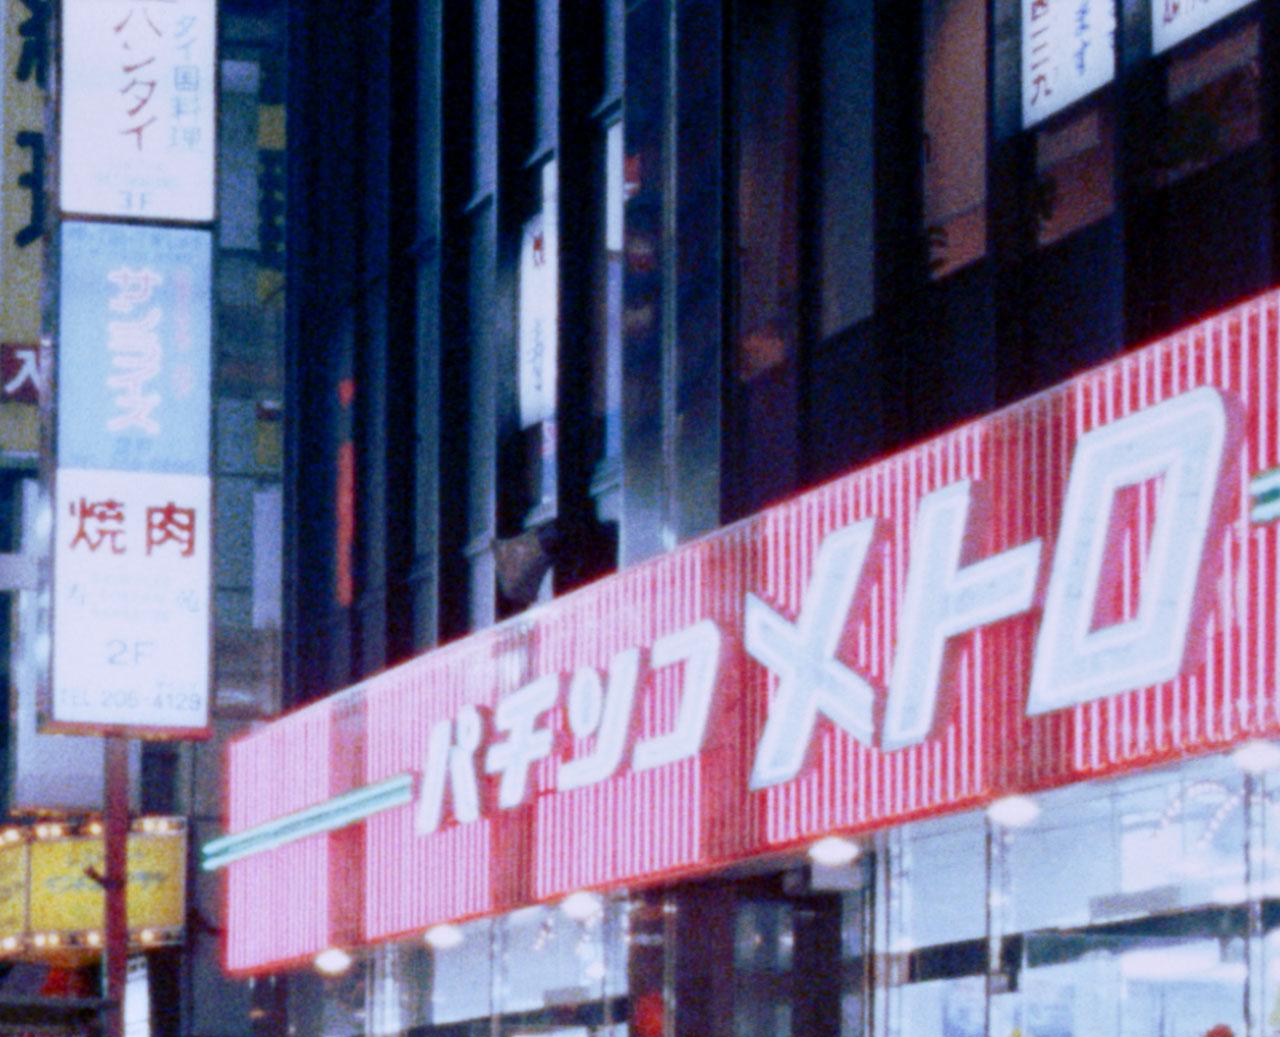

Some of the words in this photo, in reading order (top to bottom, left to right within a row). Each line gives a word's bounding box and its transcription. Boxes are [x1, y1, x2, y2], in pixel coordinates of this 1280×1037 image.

[69, 498, 196, 557] 焼肉
[745, 386, 1226, 792] メトロ
[417, 618, 722, 836] パチンコ
